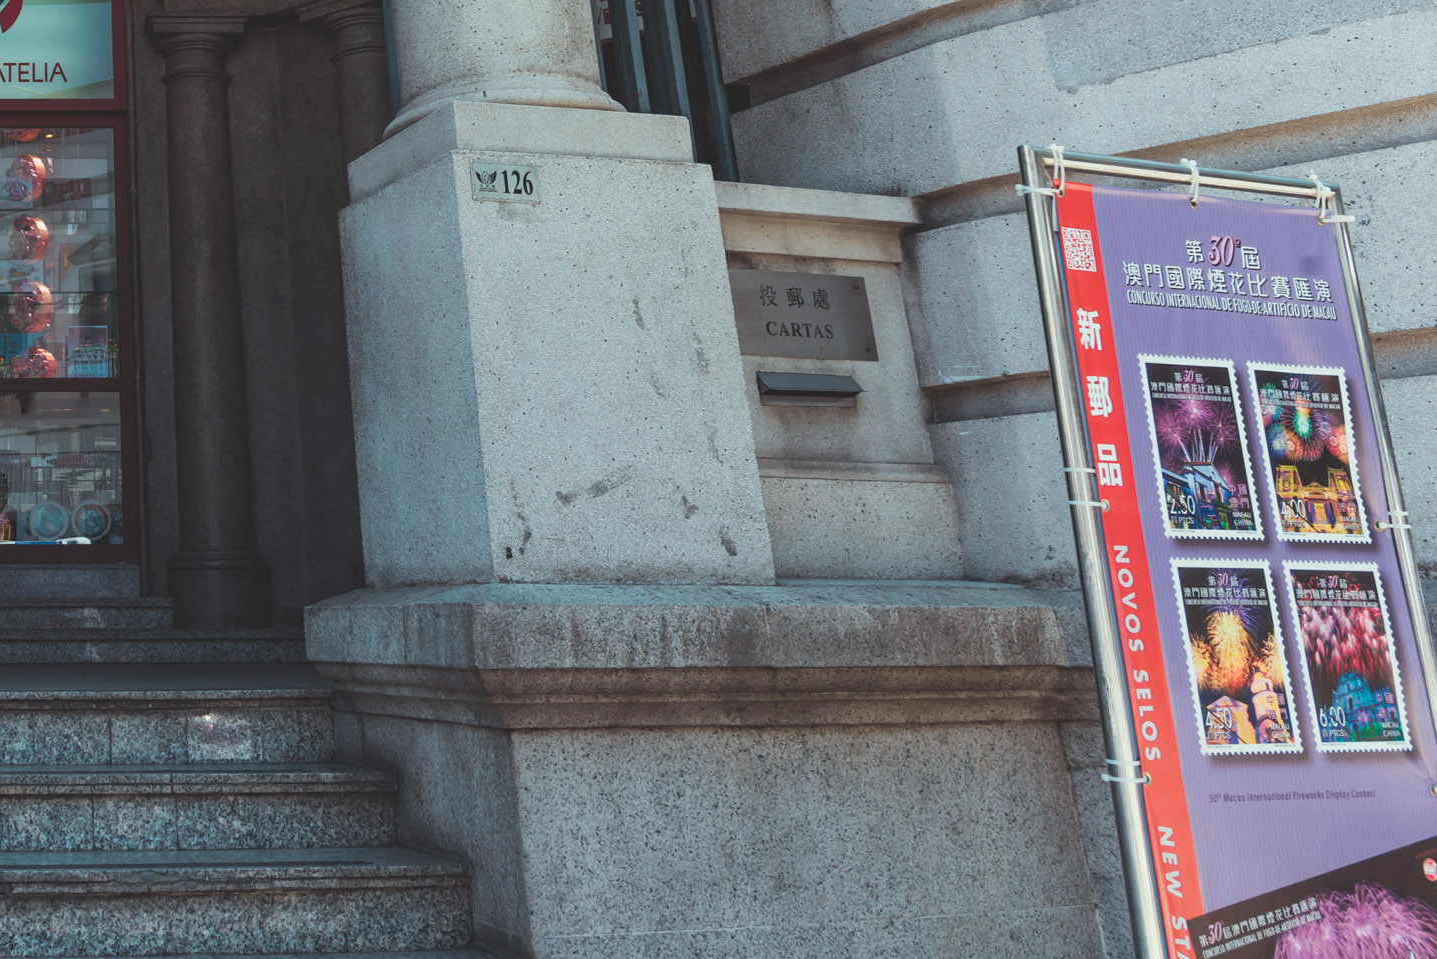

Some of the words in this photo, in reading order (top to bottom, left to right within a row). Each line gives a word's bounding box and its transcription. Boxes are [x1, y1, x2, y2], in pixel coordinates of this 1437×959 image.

[501, 169, 534, 196] 126
[1122, 261, 1334, 303] 澳門國際煙花比賽匯演
[758, 285, 831, 311] 投郵處
[1126, 290, 1166, 307] CONCURSO
[1166, 294, 1221, 312] INTERNACIONAL
[1222, 300, 1233, 312] DE
[1301, 306, 1312, 318] DE
[1313, 306, 1337, 321] MACAU
[766, 321, 834, 339] CARTAS
[1076, 308, 1123, 486] 新郵品
[1113, 545, 1145, 652] NOVOS
[1133, 669, 1161, 761] SELOS
[1247, 791, 1291, 802] International
[1293, 790, 1324, 800] Fireworks
[1326, 790, 1350, 800] Display
[1352, 789, 1376, 798] Contest
[1158, 826, 1183, 899] NEW
